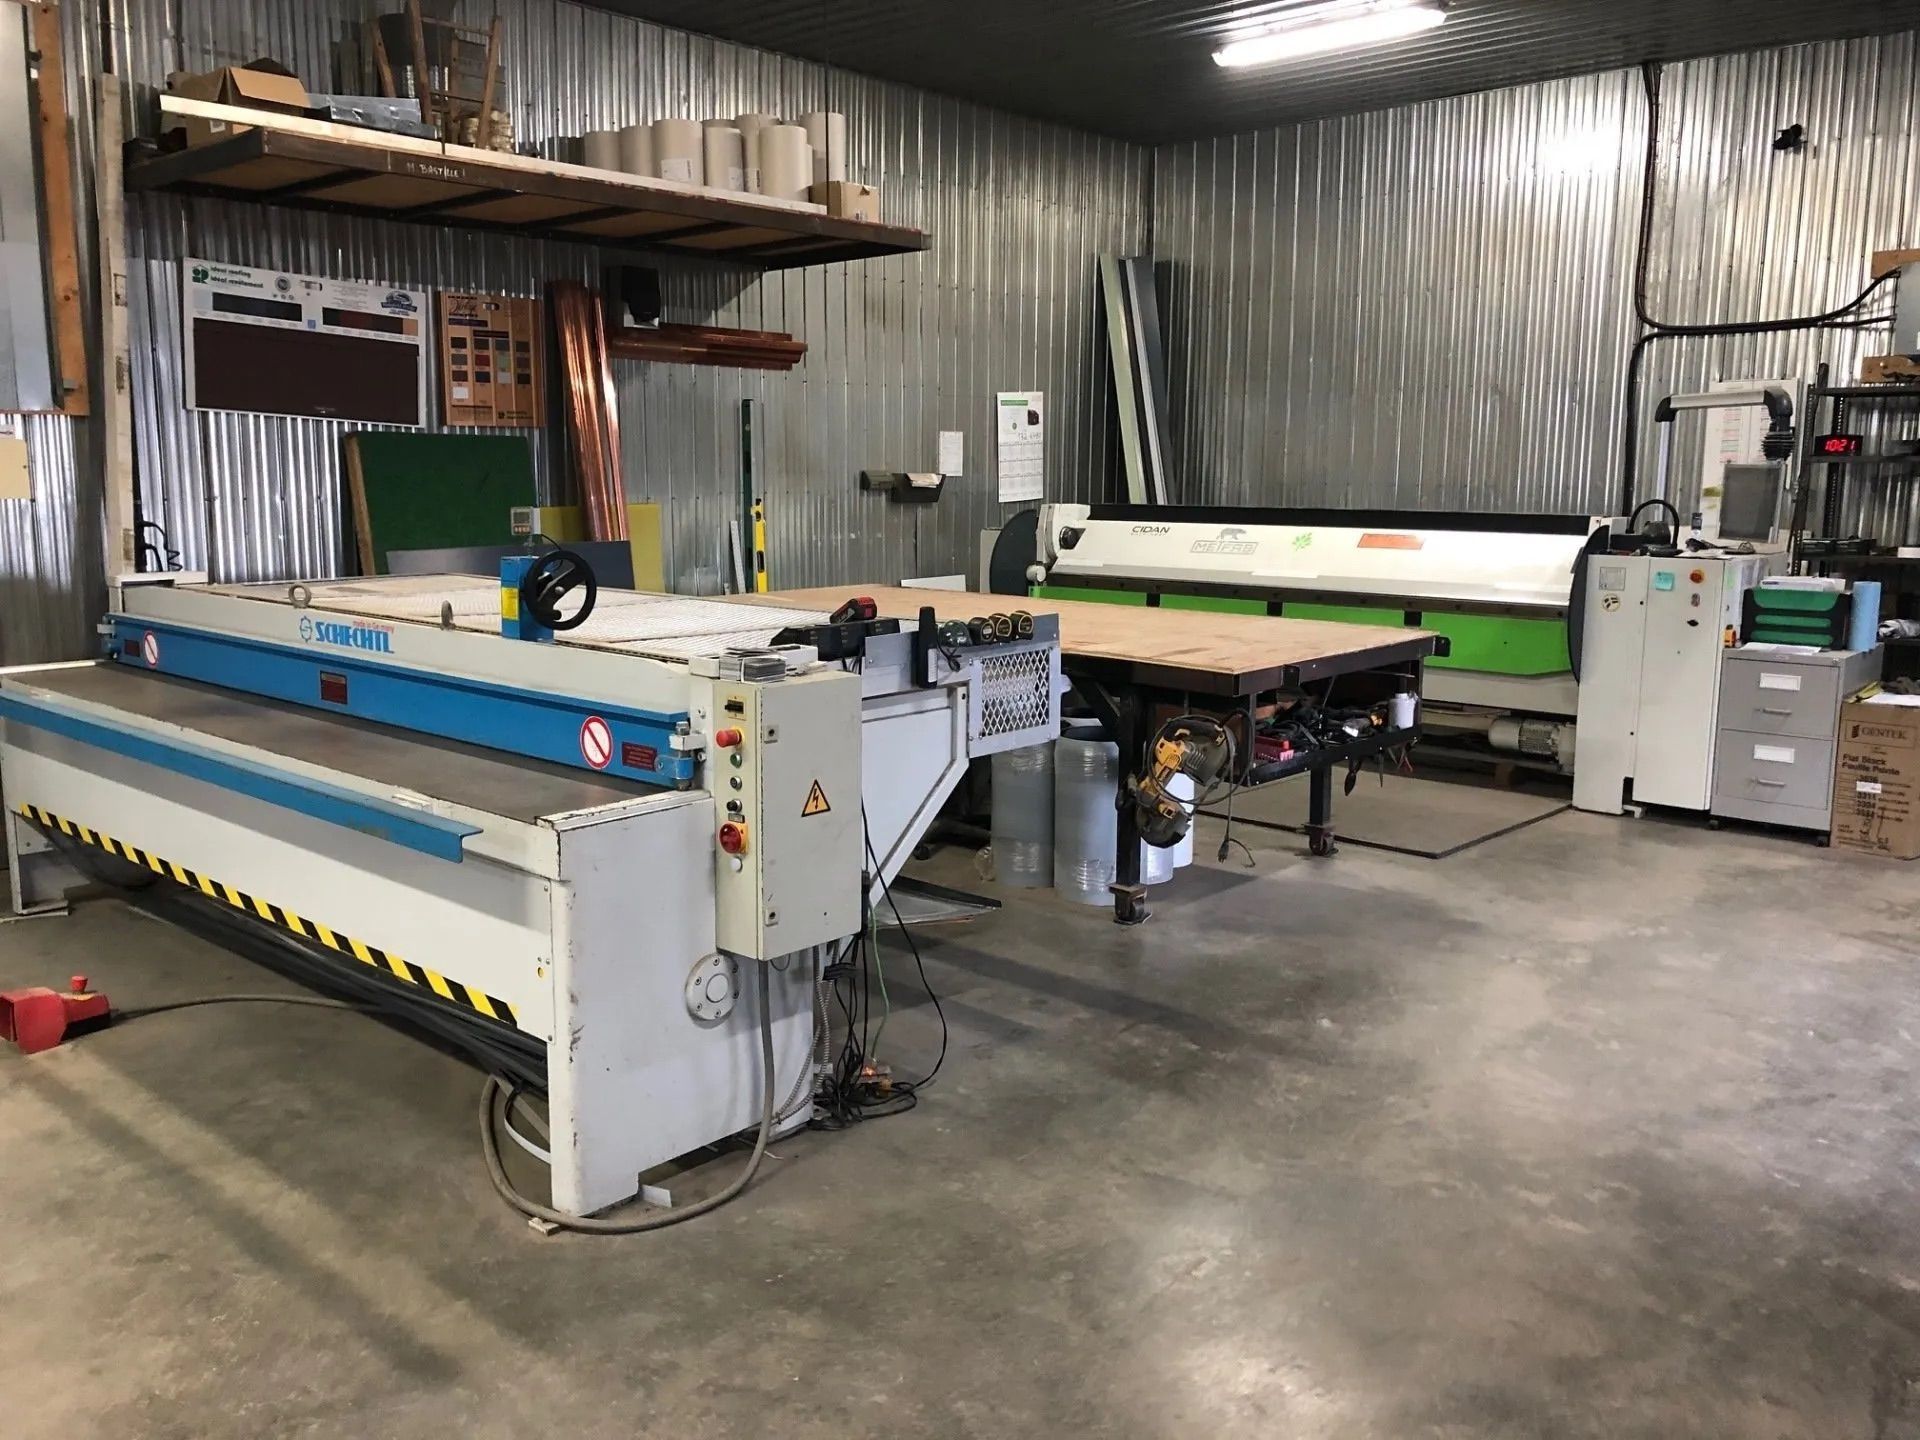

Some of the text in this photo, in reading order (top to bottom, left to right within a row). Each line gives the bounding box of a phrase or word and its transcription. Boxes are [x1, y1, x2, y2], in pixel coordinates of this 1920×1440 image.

[1132, 525, 1170, 534] CIDAN
[315, 622, 394, 653] SCHECHTL
[1862, 727, 1907, 739] GENTEK
